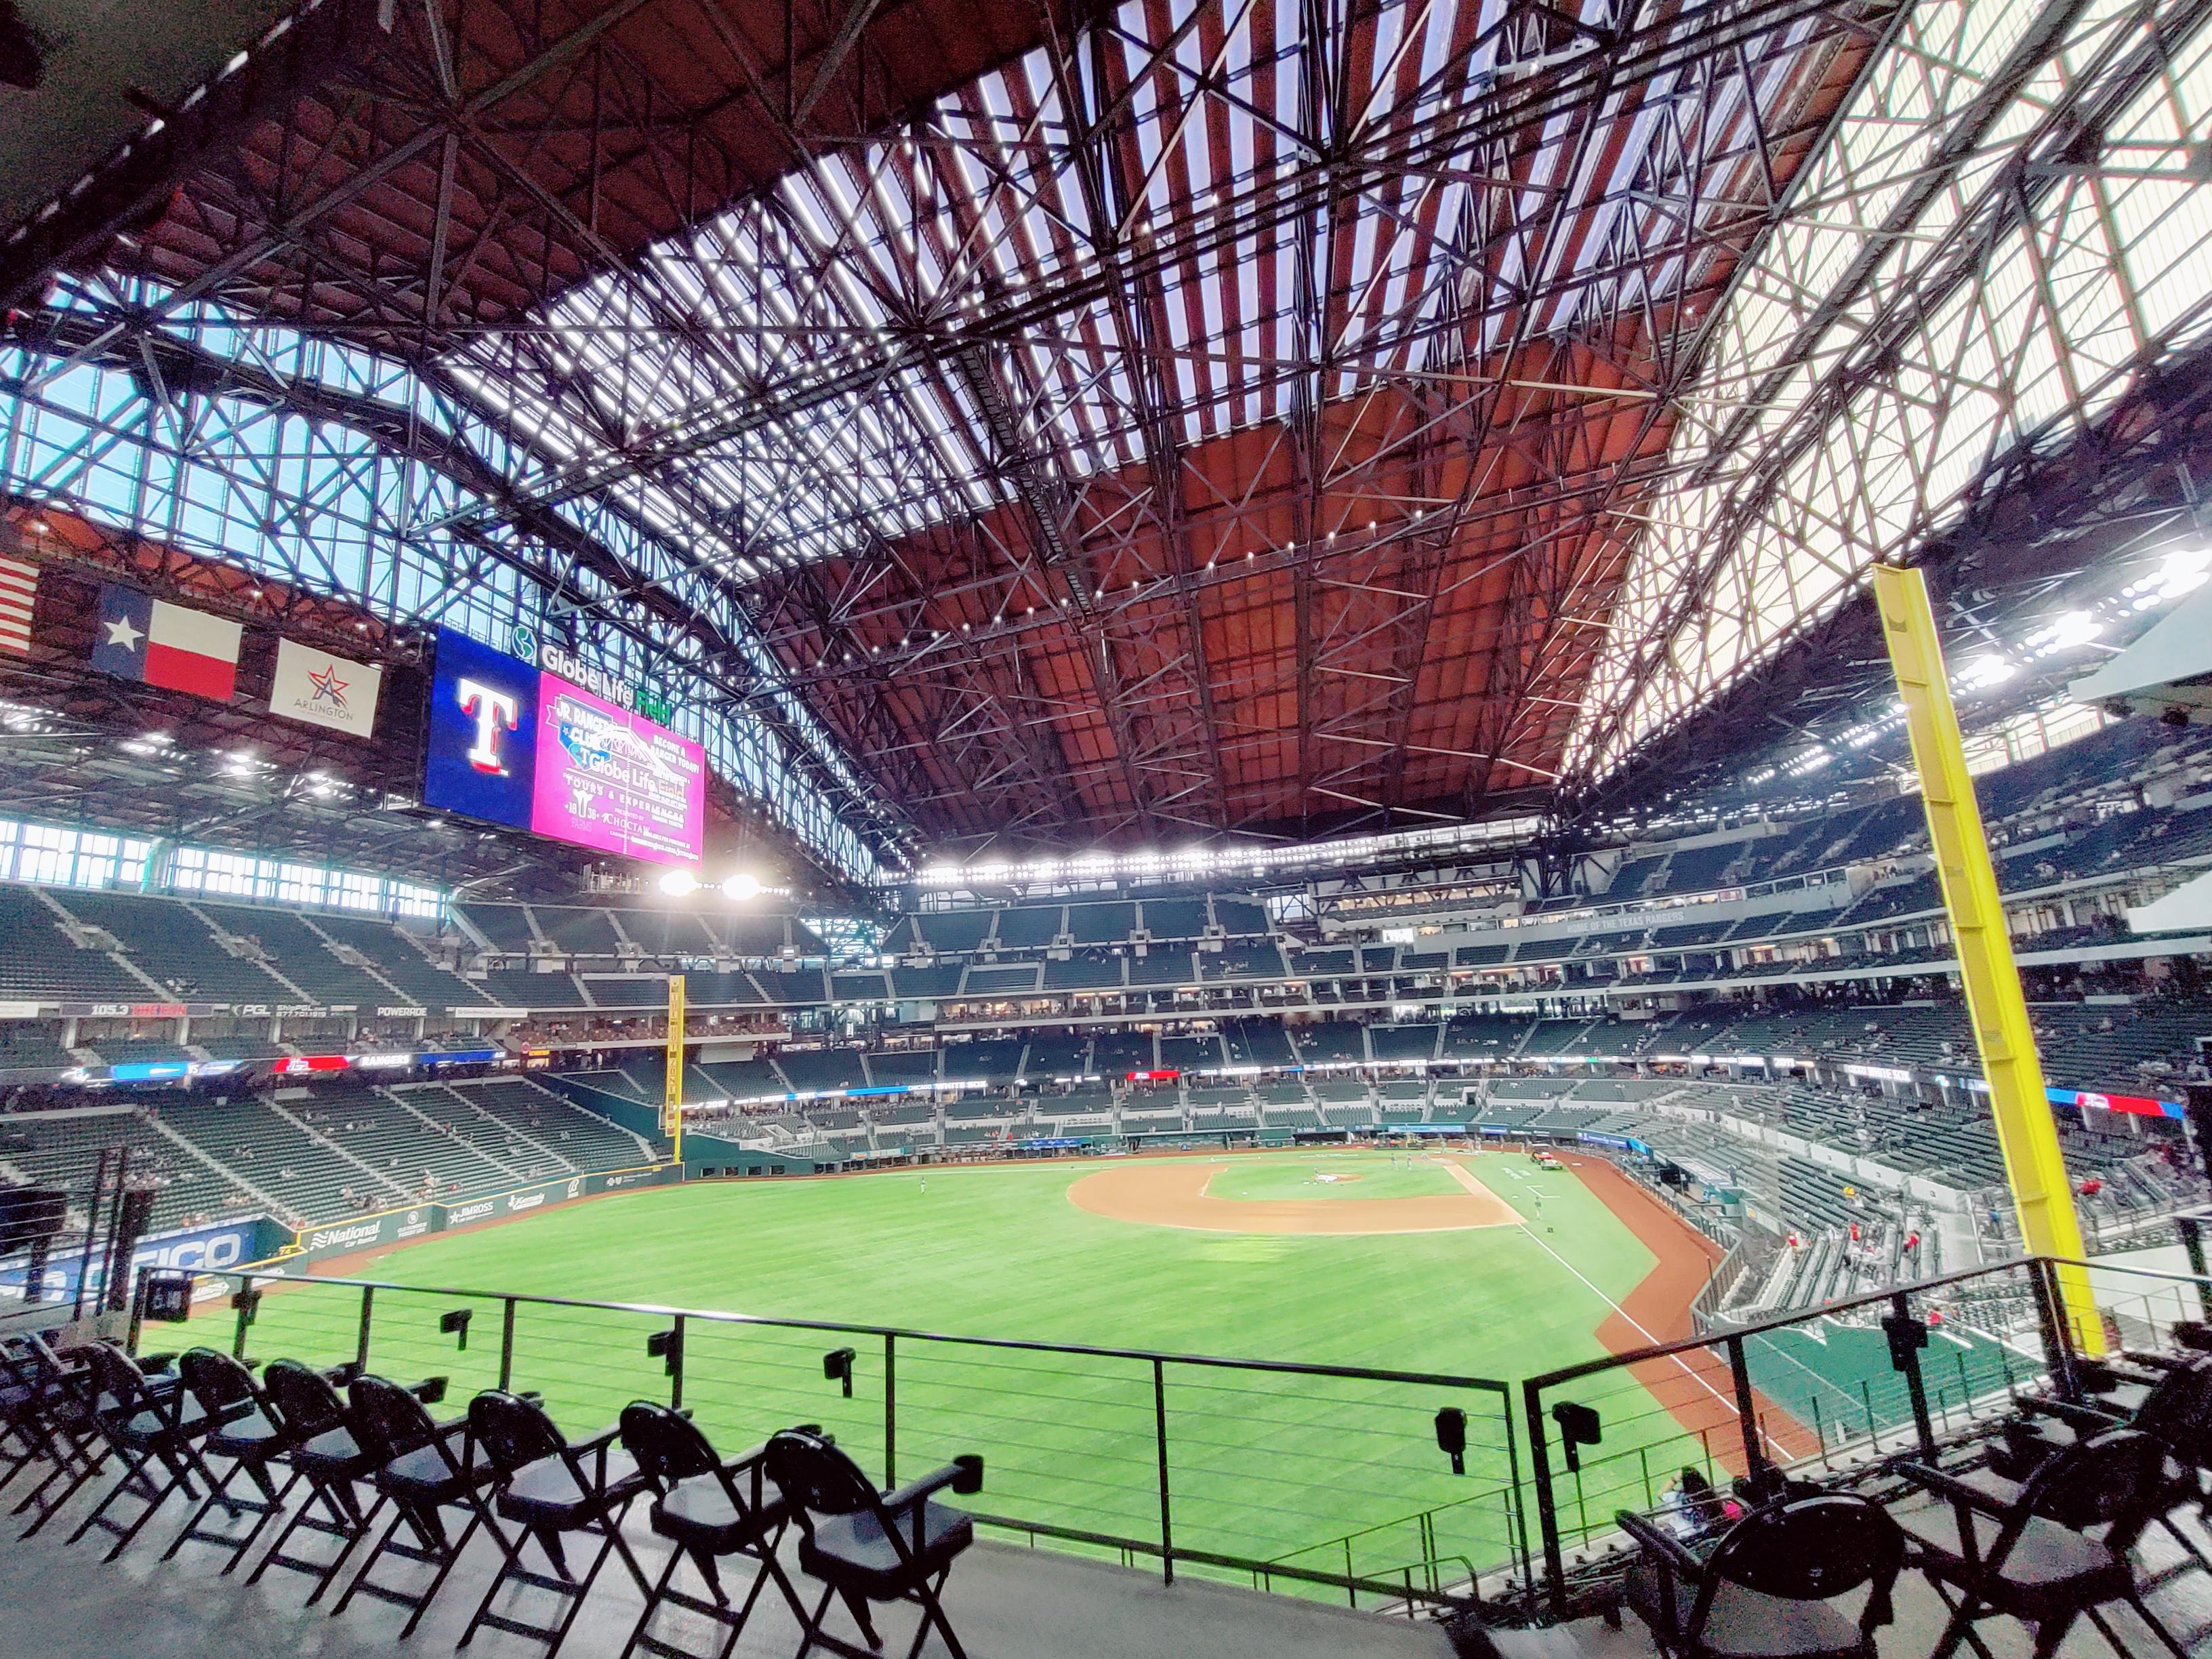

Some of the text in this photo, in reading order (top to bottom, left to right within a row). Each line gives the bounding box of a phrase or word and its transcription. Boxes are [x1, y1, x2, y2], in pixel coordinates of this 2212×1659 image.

[542, 643, 673, 725] Globe Life Field
[293, 698, 354, 720] ARLINGTON
[458, 678, 518, 775] T
[589, 753, 630, 784] Globe
[562, 773, 604, 796] TOURS
[1567, 911, 1685, 933] HOME OF THE TEXAS RANGERS
[91, 1004, 129, 1015] 105.3
[243, 1004, 271, 1015] PGL
[377, 1006, 428, 1017] POWERADE
[362, 1054, 409, 1066] RANGERS
